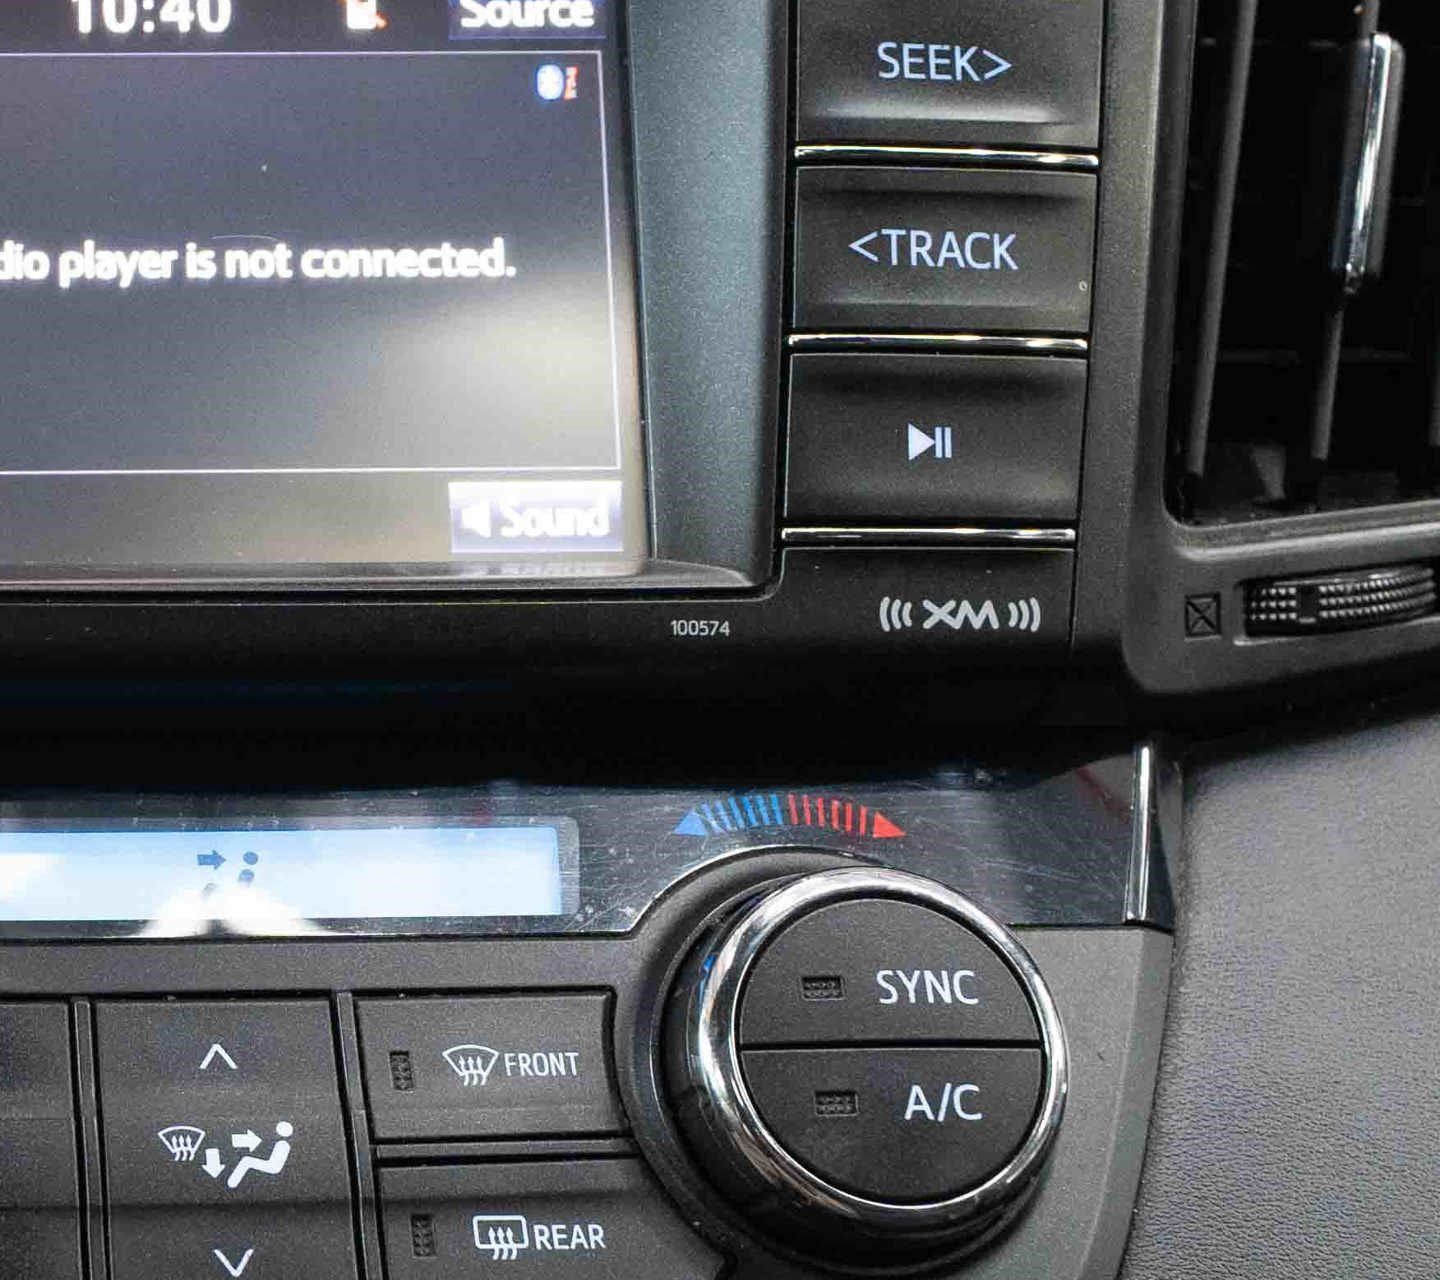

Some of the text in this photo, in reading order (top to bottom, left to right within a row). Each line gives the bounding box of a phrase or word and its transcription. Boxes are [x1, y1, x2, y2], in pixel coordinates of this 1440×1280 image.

[58, 239, 179, 289] player
[185, 241, 218, 280] is
[224, 240, 294, 280] not
[300, 237, 517, 280] connected.
[499, 497, 611, 538] Sound
[670, 620, 730, 637] 100574
[875, 969, 980, 1006] SYNC
[504, 1051, 579, 1077] FRONT
[903, 1083, 983, 1121] A/C
[533, 1223, 606, 1251] REAR
